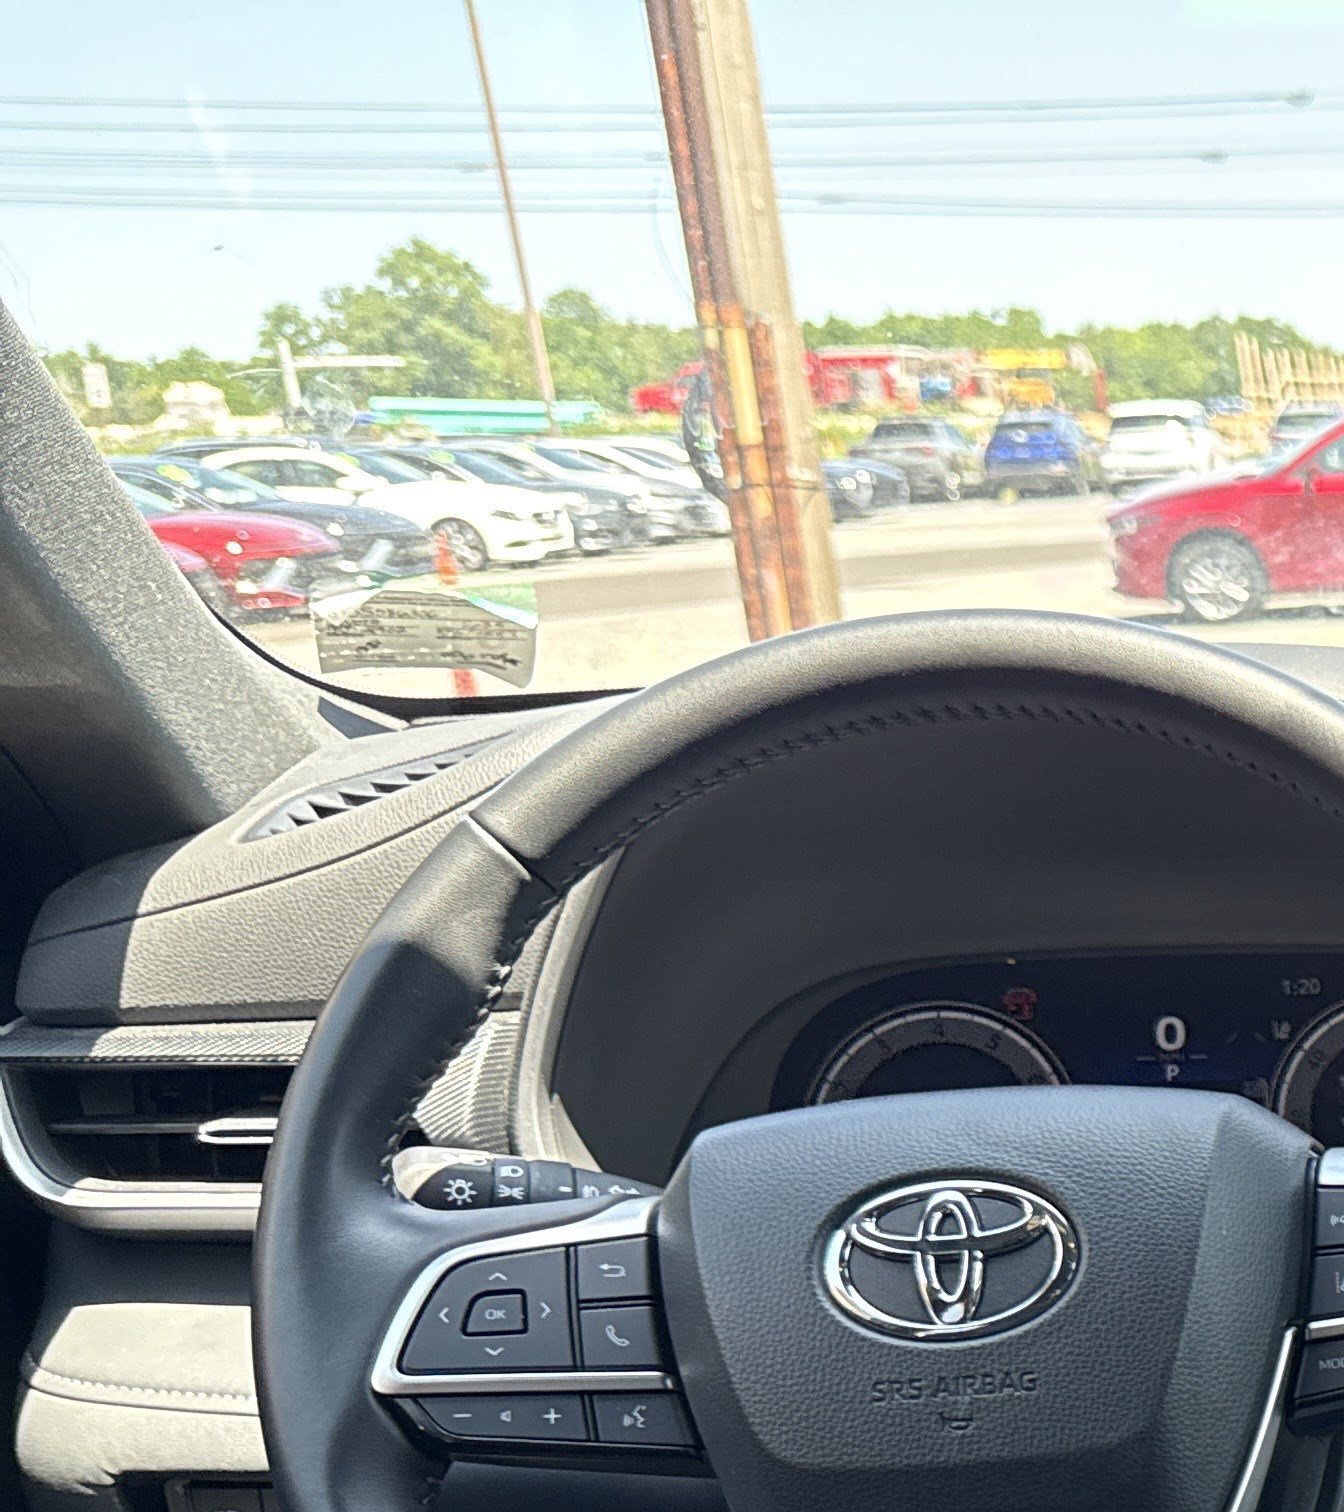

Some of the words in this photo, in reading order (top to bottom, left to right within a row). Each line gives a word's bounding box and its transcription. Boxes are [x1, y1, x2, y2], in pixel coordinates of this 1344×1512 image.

[1281, 978, 1322, 996] 1:20
[1155, 1015, 1186, 1052] 0
[485, 1308, 507, 1321] OK
[871, 1378, 923, 1403] SRS
[933, 1370, 1041, 1398] AIRBAG
